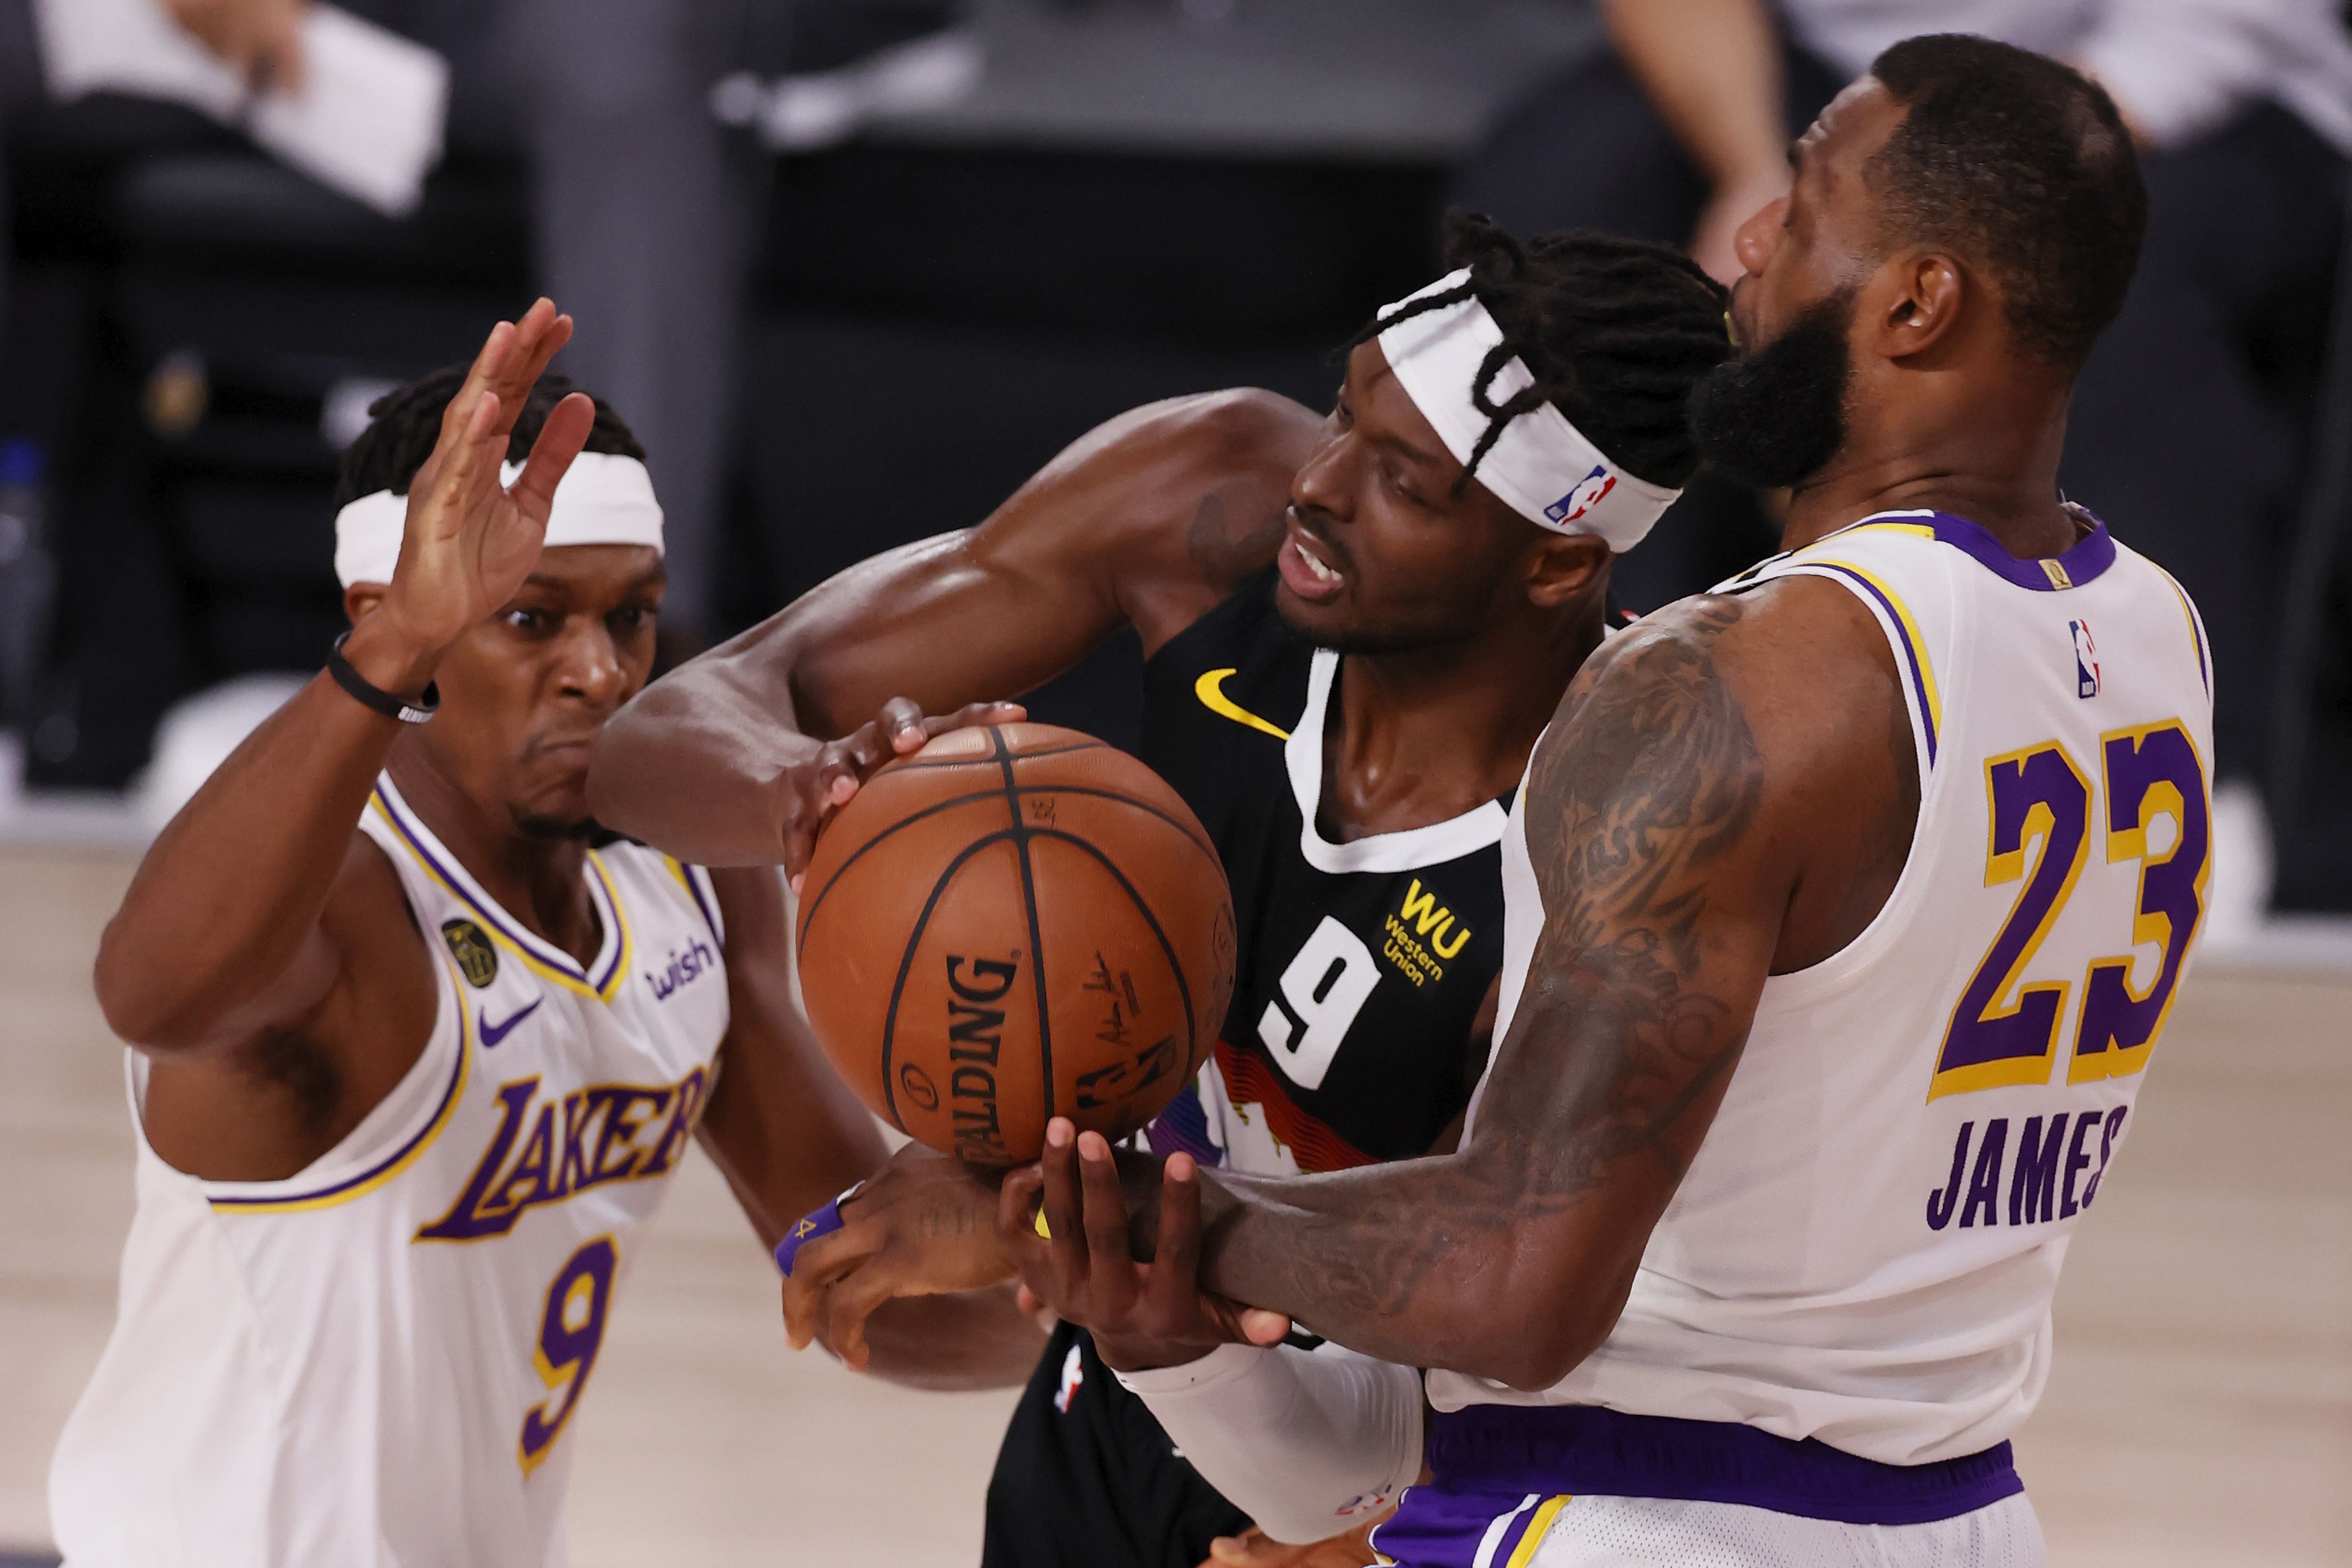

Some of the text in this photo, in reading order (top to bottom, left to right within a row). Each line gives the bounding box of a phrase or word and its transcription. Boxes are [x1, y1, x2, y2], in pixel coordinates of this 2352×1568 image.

[644, 934, 714, 1001] wish
[1383, 938, 1425, 987] Union
[1384, 914, 1444, 982] Western
[1400, 878, 1471, 960] WU
[1927, 717, 2212, 1105] 23
[946, 954, 1017, 1163] PALDING
[1256, 915, 1383, 1090] 9
[411, 1064, 708, 1244] LAKER
[1927, 1105, 2127, 1231] JAMES
[518, 1232, 621, 1482] 9
